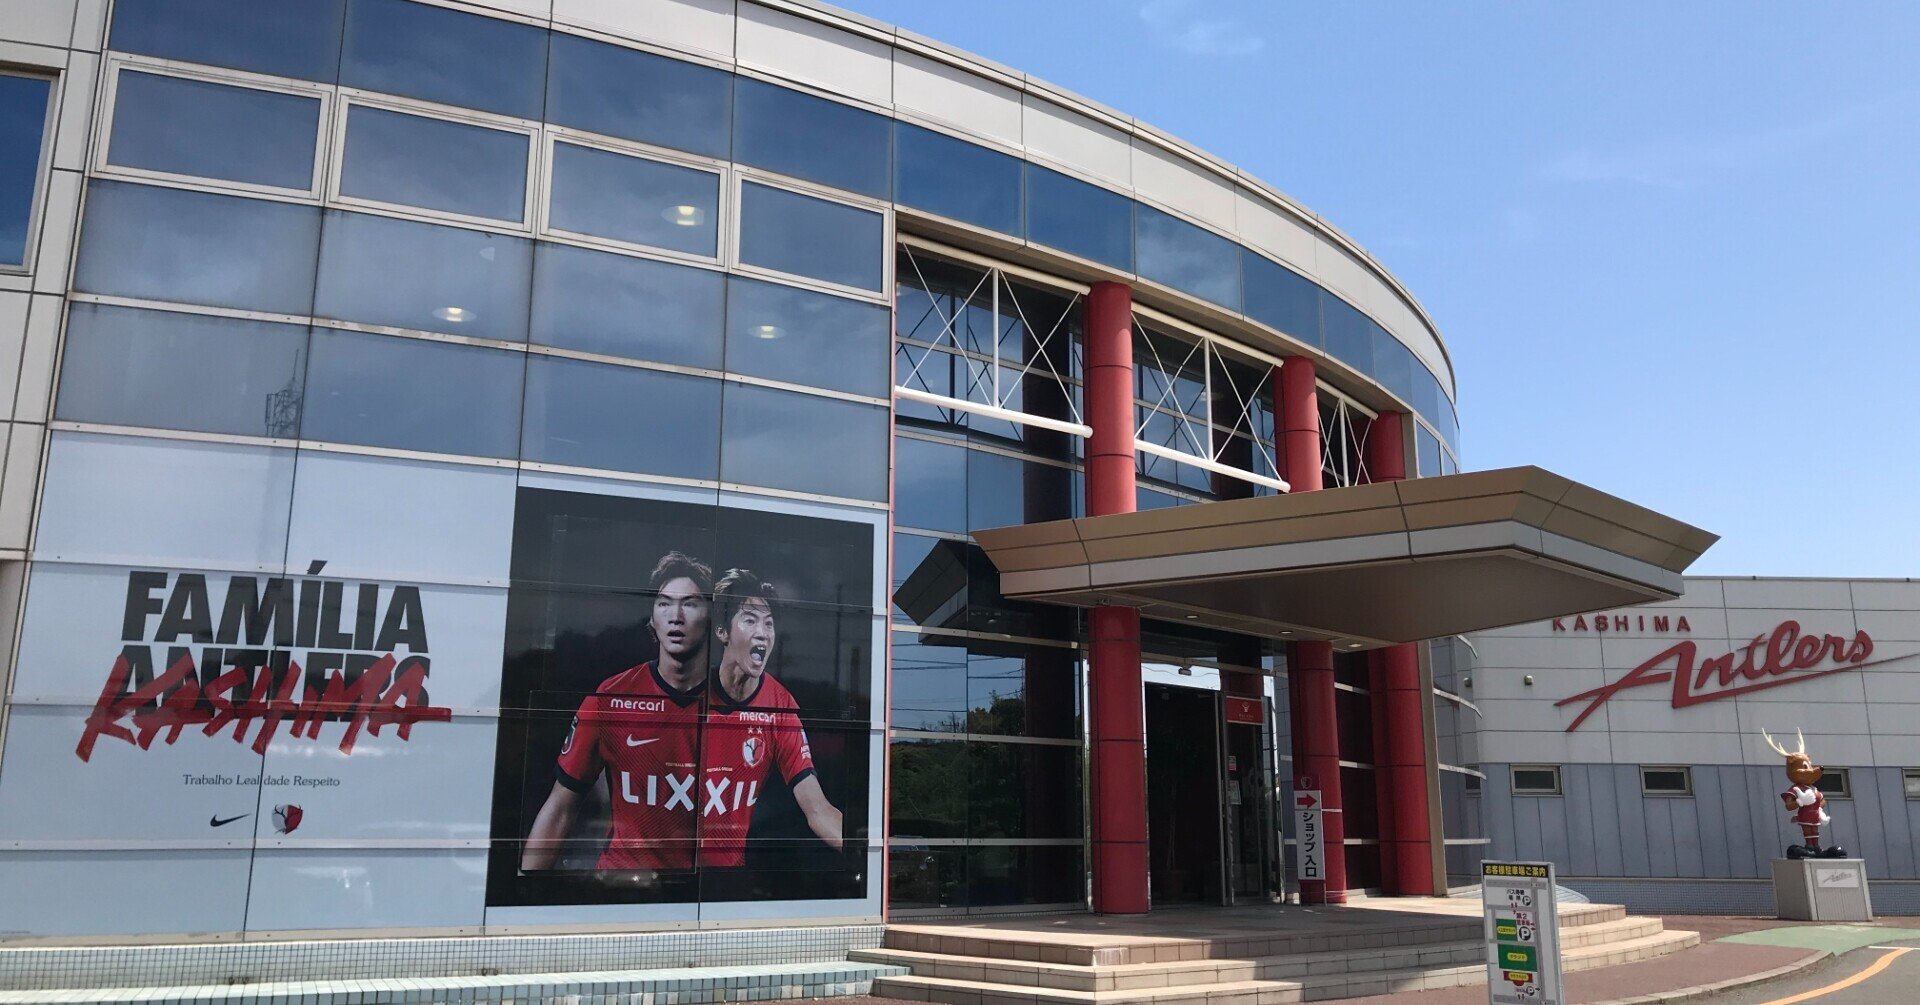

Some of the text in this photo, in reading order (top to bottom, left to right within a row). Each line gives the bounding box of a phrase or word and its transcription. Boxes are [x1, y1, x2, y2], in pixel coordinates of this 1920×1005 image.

[121, 560, 429, 653] FAMÍLIA
[1553, 615, 1692, 632] KASHIMA
[1553, 620, 1905, 733] Antlers
[76, 653, 452, 763] KASHIMA
[610, 698, 665, 712] mercari
[739, 711, 776, 724] mercari
[183, 774, 232, 785] Trabalho
[293, 776, 341, 788] Respeito
[1302, 812, 1318, 878] ショップ入口
